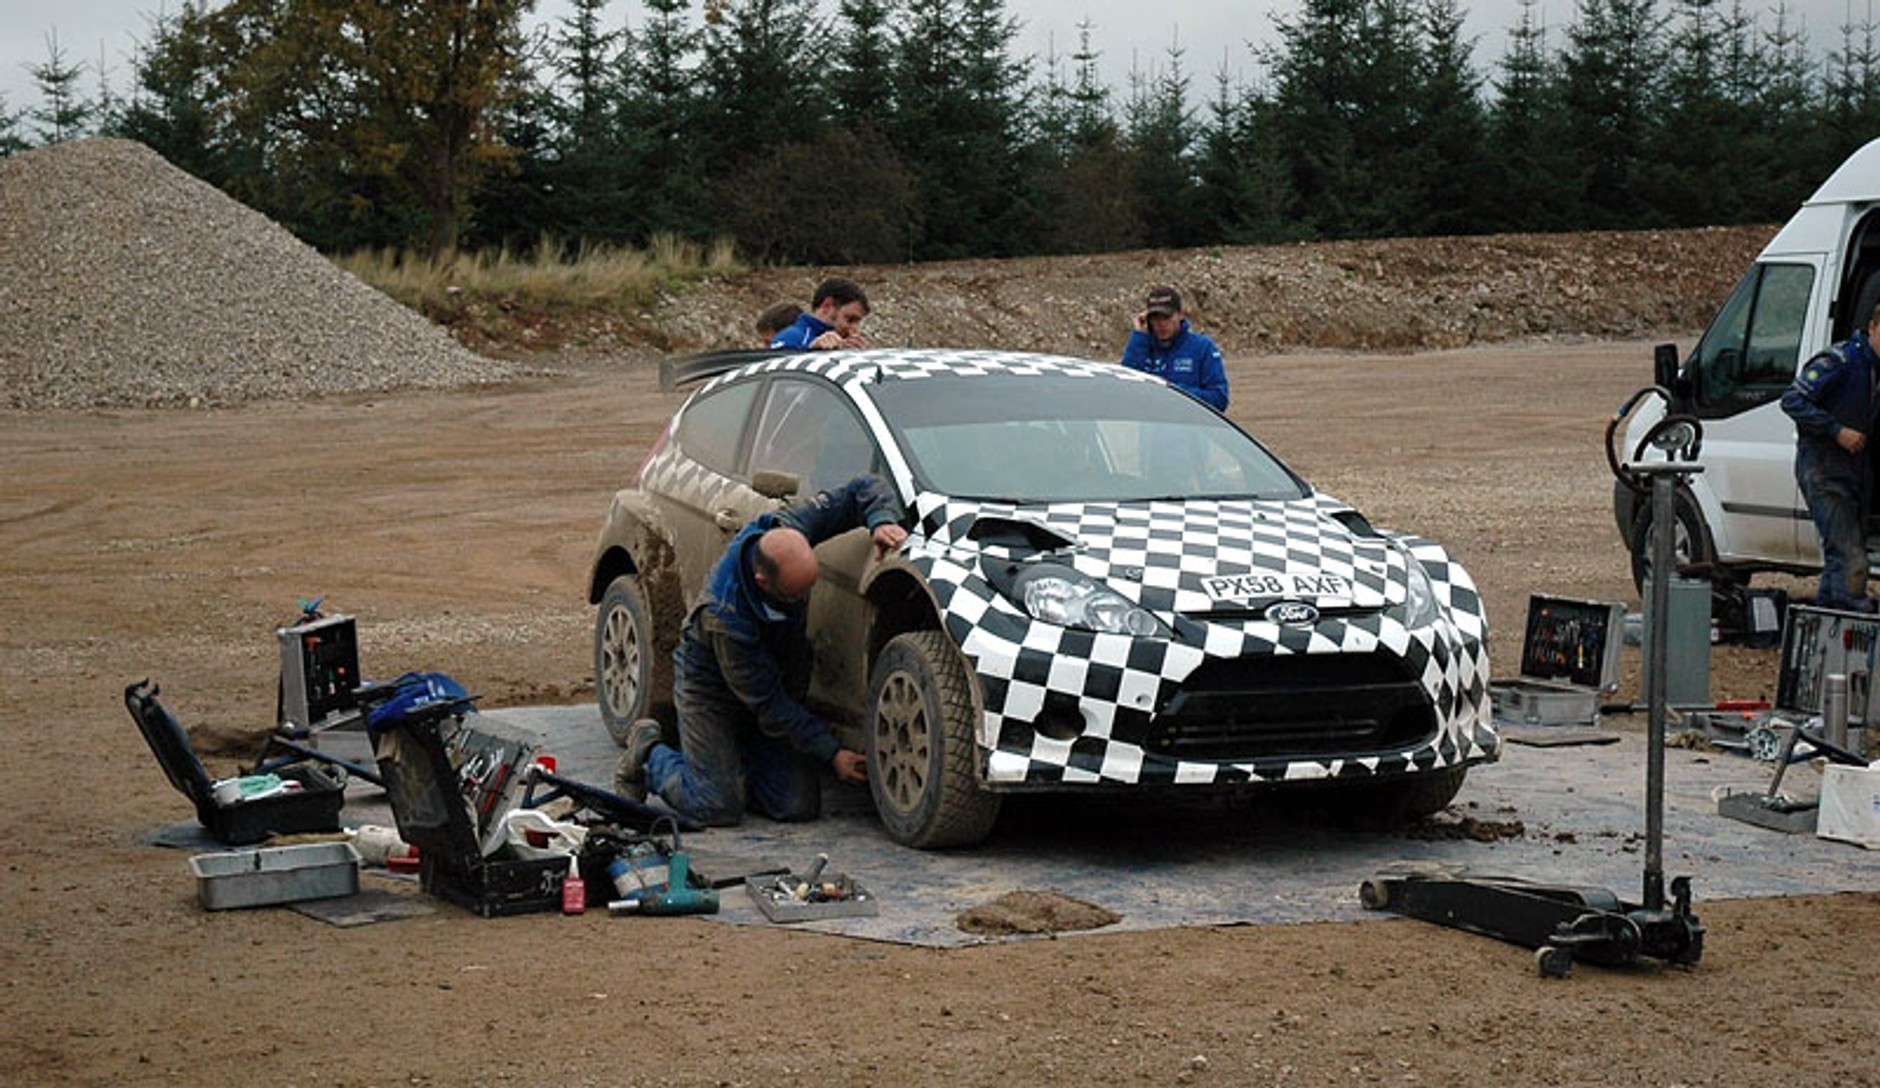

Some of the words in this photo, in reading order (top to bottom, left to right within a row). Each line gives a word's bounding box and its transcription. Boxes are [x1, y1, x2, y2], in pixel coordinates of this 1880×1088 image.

[1208, 575, 1284, 597] PX58
[1292, 575, 1342, 594] AXF
[1278, 605, 1309, 621] Ford
